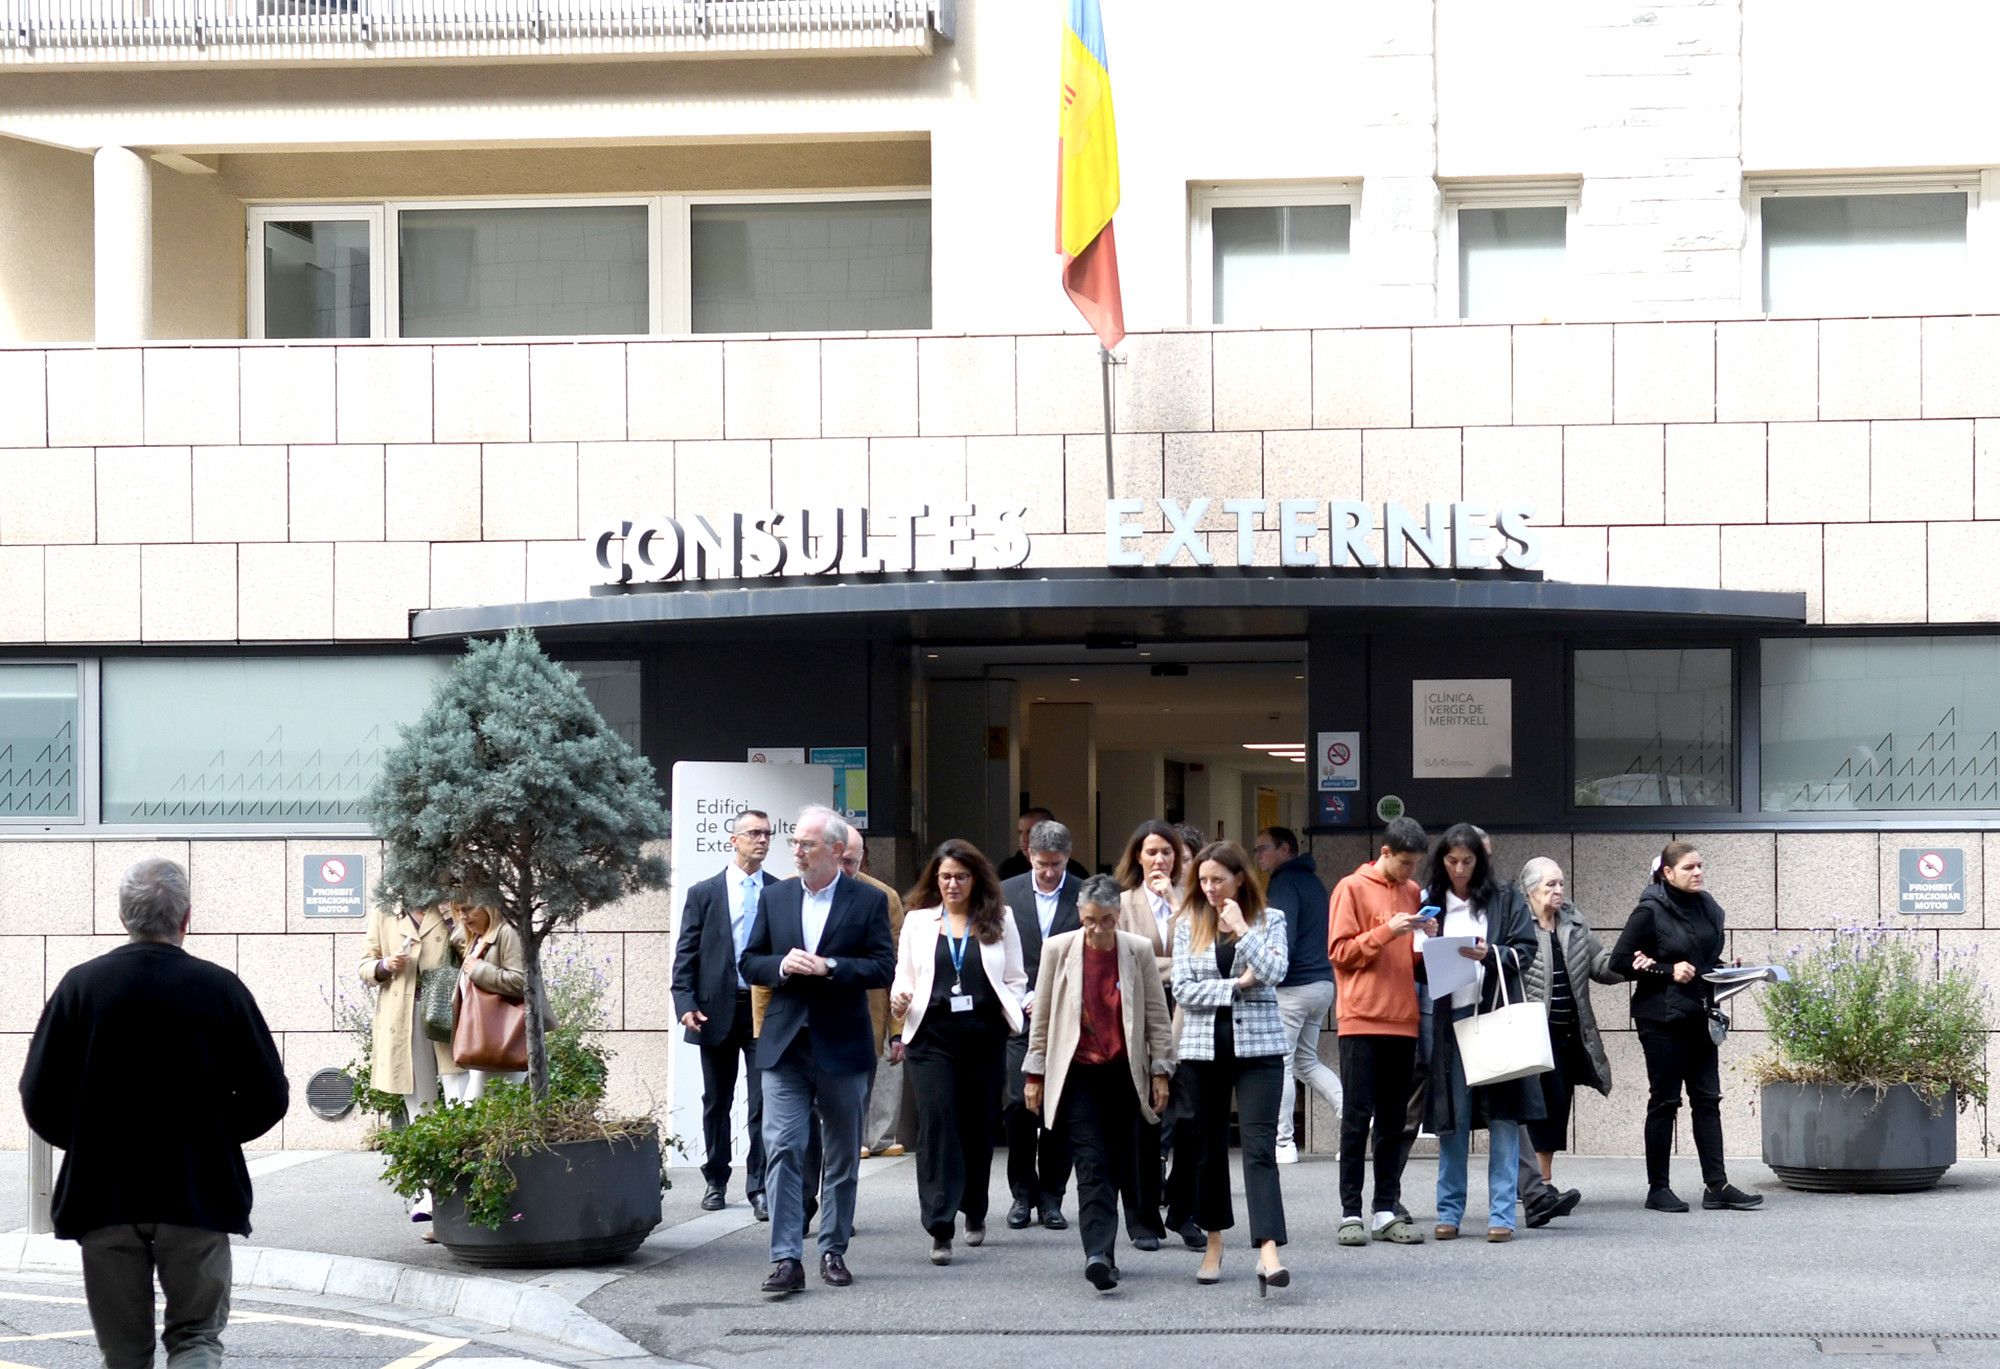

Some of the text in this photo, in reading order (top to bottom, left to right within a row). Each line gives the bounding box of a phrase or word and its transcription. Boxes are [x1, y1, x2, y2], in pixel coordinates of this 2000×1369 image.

[587, 499, 1542, 583] CONSULTES EXTERNES
[1428, 691, 1475, 703] CLÍNICA
[1428, 704, 1484, 714] VERGE DE
[1429, 715, 1489, 726] MERITXELL
[696, 799, 749, 814] Edifici
[696, 818, 718, 834] de
[312, 888, 354, 896] PROHIBIT
[1908, 883, 1954, 892] PROHIBIT
[1902, 892, 1961, 901] ESTACIONAR
[317, 905, 349, 913] MOTOS
[1914, 901, 1949, 910] MOTOS
